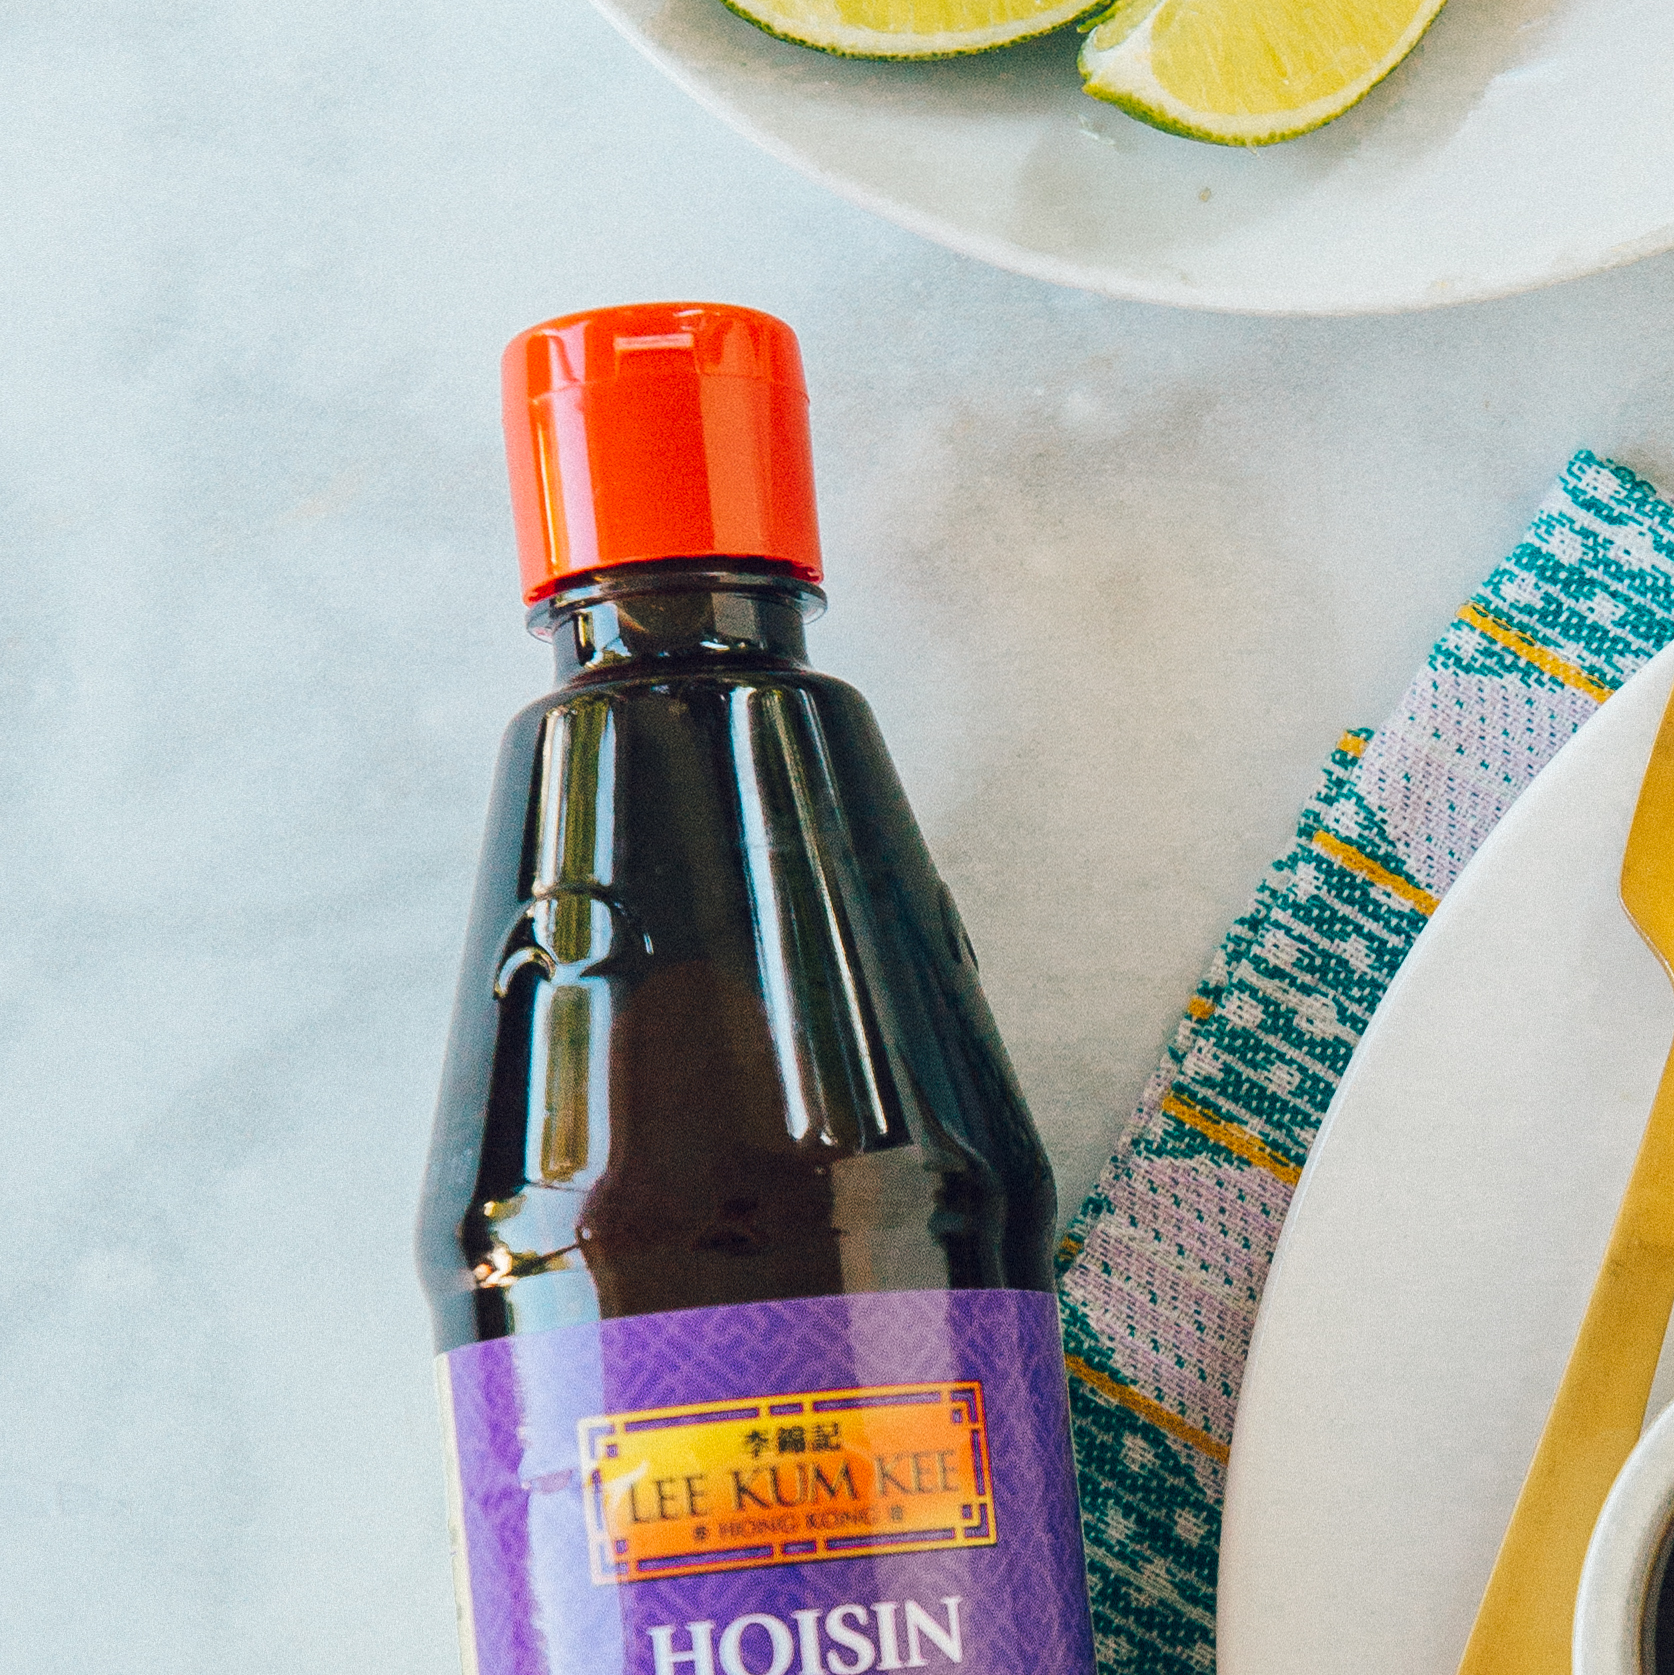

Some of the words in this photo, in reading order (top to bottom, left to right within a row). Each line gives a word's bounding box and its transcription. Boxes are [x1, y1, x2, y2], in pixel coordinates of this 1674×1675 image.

[629, 1474, 711, 1523] LEE
[731, 1459, 859, 1510] KUM
[874, 1449, 959, 1497] KEE
[719, 1516, 797, 1538] HONG
[805, 1508, 877, 1529] KONG
